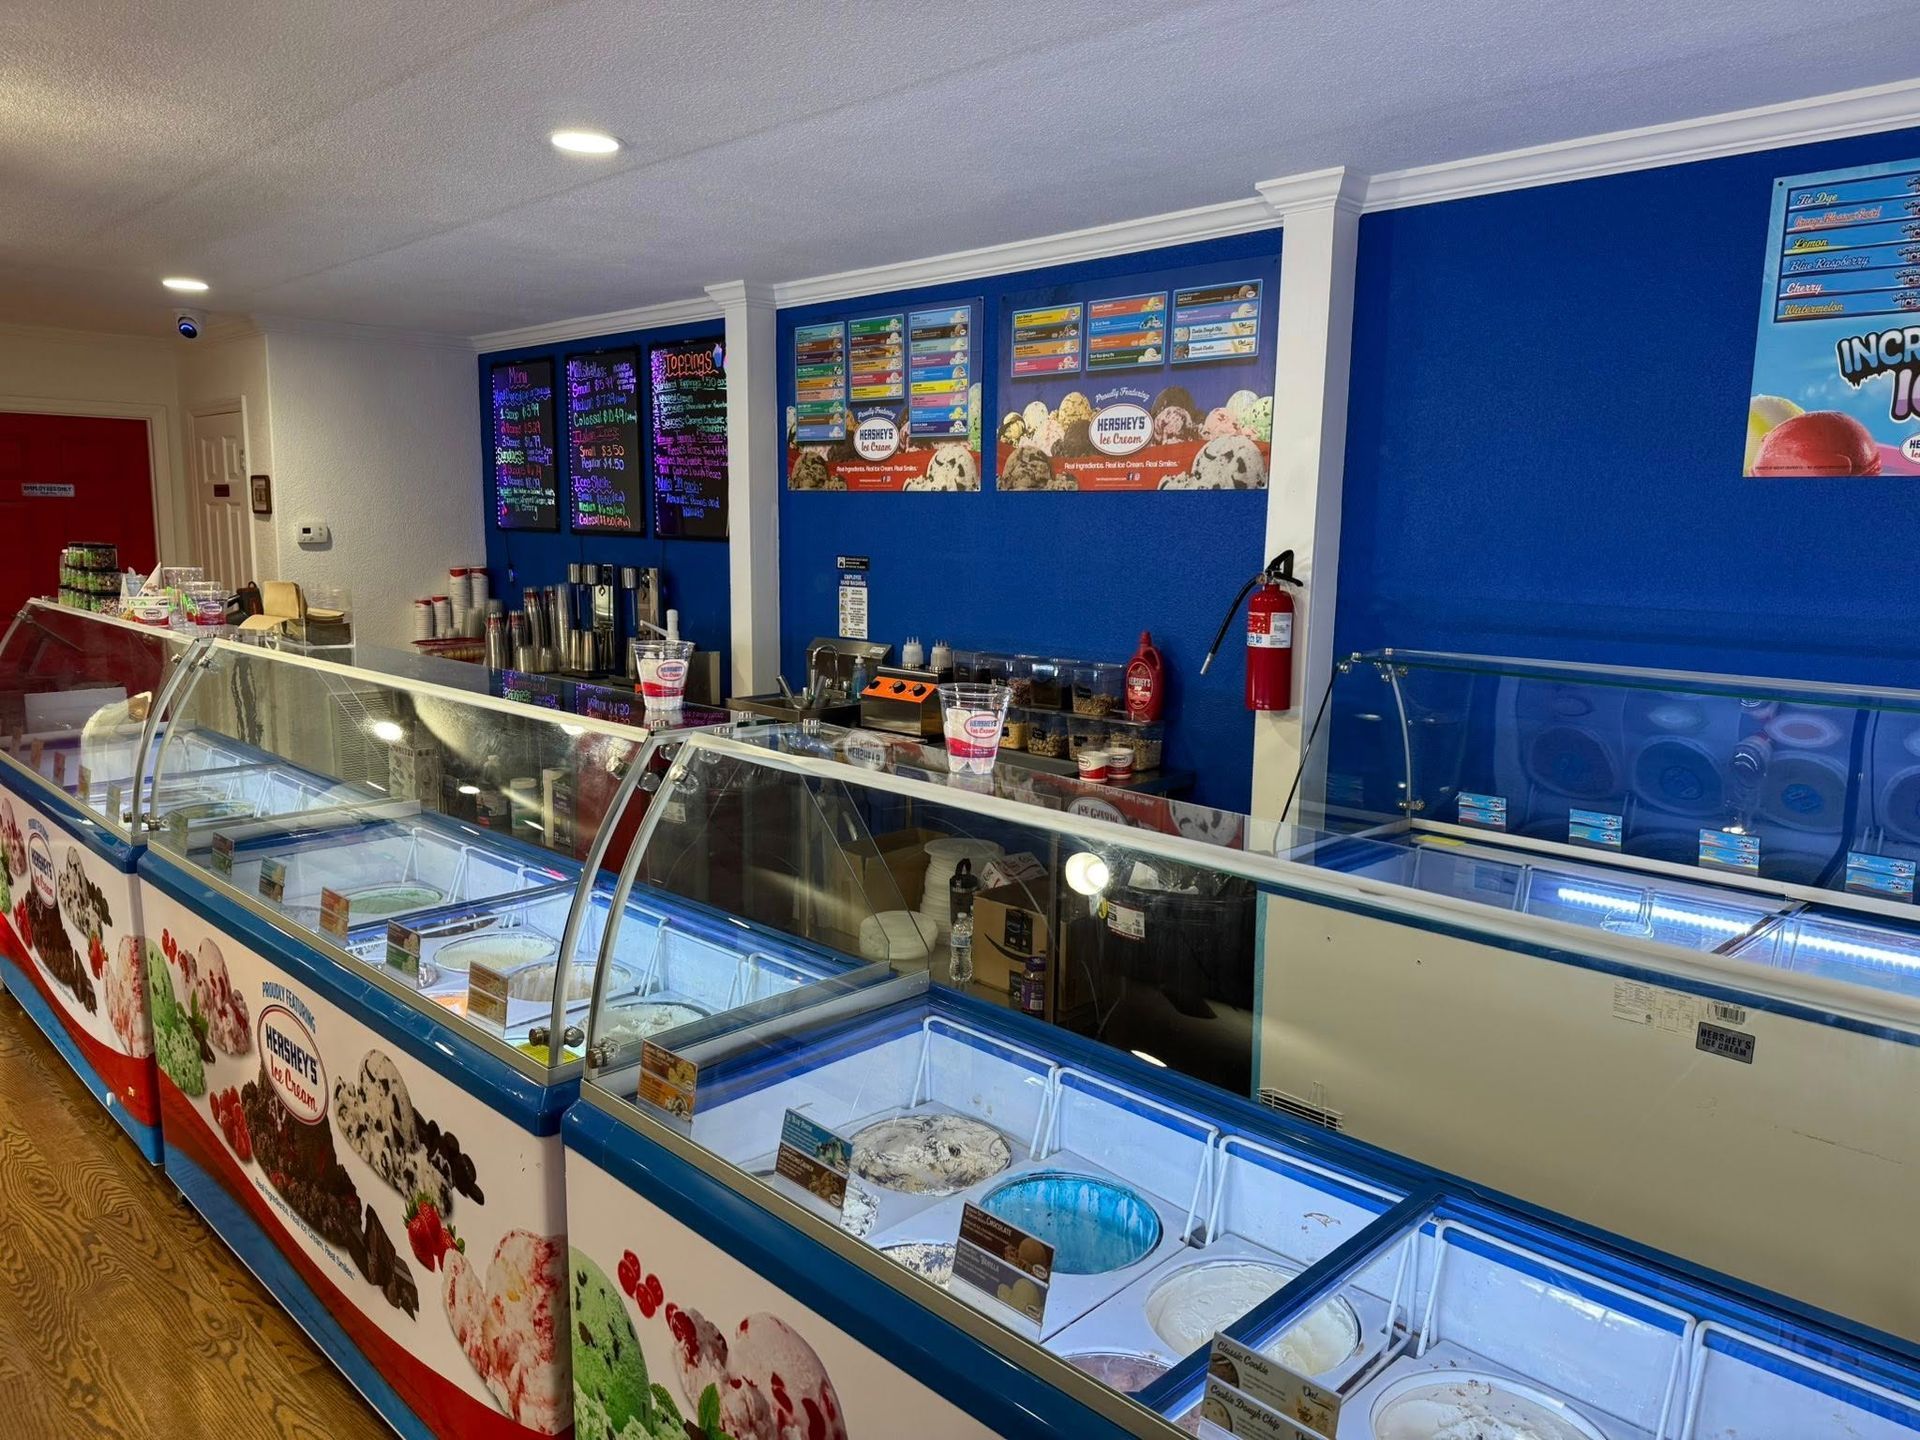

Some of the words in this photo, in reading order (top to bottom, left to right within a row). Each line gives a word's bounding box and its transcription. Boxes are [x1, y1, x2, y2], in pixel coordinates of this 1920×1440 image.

[1797, 194, 1813, 205] Tie
[1817, 192, 1838, 205] Dye
[1793, 238, 1828, 250] Lemon
[1790, 260, 1814, 271] Blue
[1815, 256, 1870, 271] Raspberry
[1786, 282, 1823, 295] Cherry
[1784, 302, 1844, 315] Watermelon
[508, 366, 528, 386] Menu
[572, 382, 591, 398] Small
[1096, 387, 1119, 403] Proudly
[1120, 387, 1150, 402] Featuring
[573, 409, 602, 427] Colossal
[1097, 416, 1146, 432] HERSHEY'S
[860, 428, 894, 441] HERSHEY'S
[1099, 432, 1112, 445] Ice
[1113, 432, 1142, 445] Cream
[580, 446, 597, 457] Small
[862, 441, 870, 452] Ice
[871, 441, 891, 452] Cream
[1075, 462, 1104, 470] Ingredients.
[262, 981, 285, 1002] PROUDLY
[286, 988, 316, 1034] FEATURING
[1701, 1028, 1752, 1050] HERSHEY'S
[1702, 1037, 1716, 1047] ICE
[1718, 1042, 1747, 1057] CREAM
[265, 1022, 318, 1086] HERSHEY'S
[270, 1053, 284, 1085] Ice
[284, 1067, 318, 1113] Cream
[1217, 1341, 1243, 1363] Classic
[1243, 1355, 1269, 1375] Cookie
[1210, 1384, 1234, 1404] Cookie
[1234, 1398, 1261, 1420] Dough
[1262, 1413, 1280, 1431] Chip
